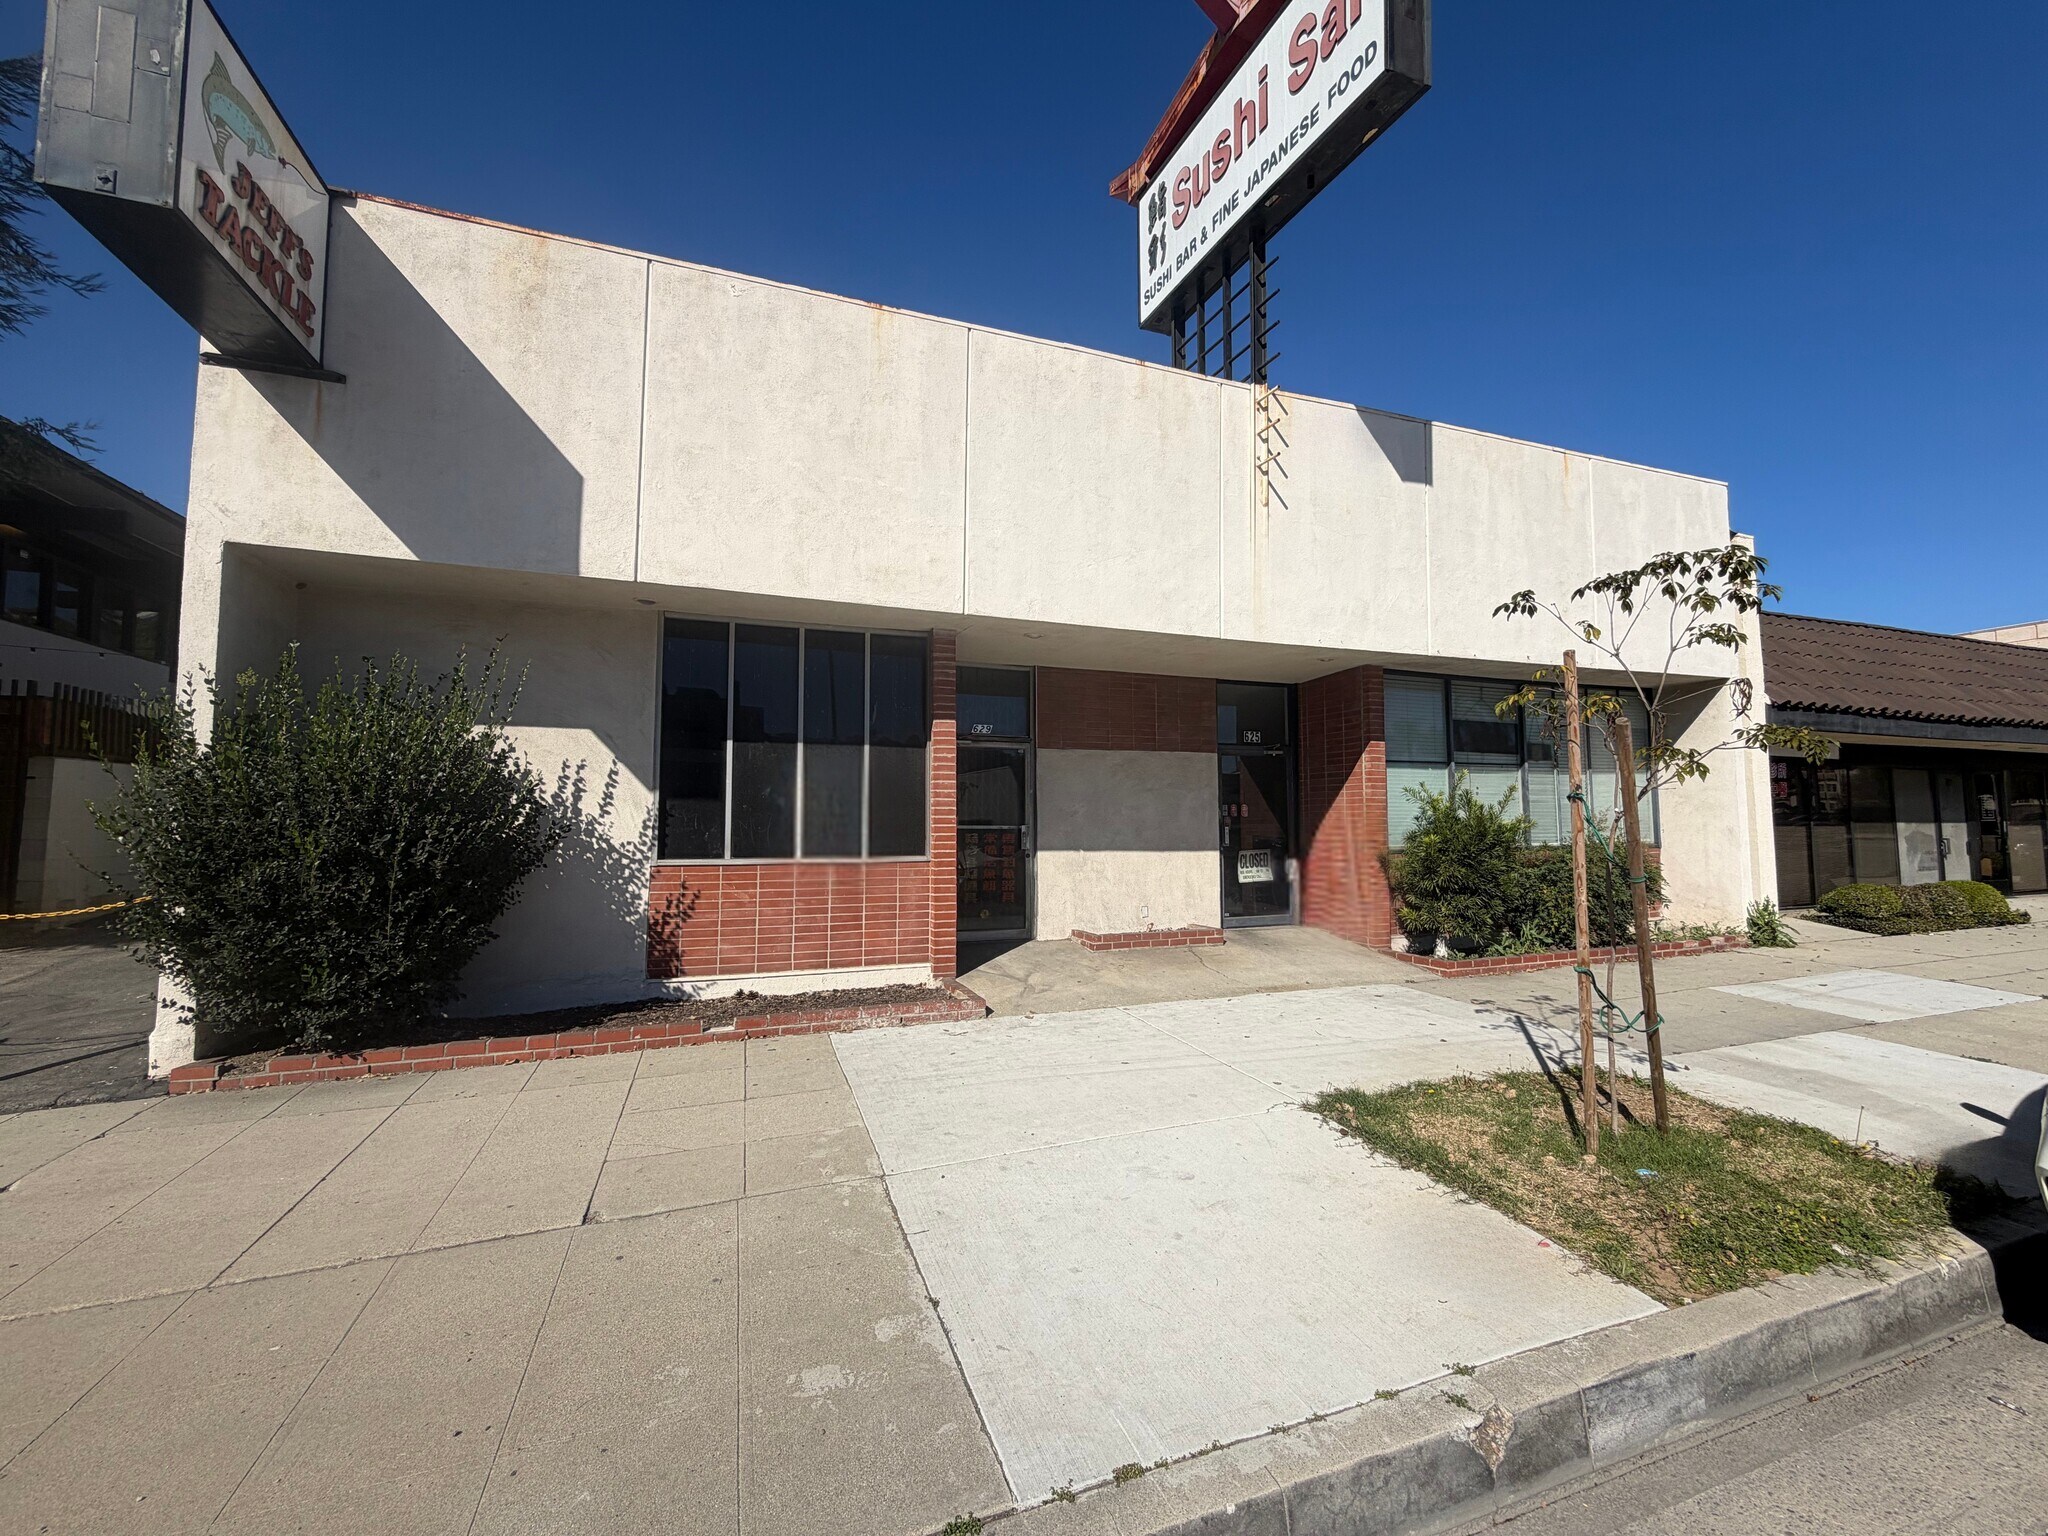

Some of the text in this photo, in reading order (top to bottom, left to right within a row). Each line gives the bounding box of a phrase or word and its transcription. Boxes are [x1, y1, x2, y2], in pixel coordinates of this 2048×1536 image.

[1144, 40, 1377, 305] SUSHI BAR & FINE JAPANESE FOOD
[1172, 64, 1268, 231] Sushi
[198, 168, 316, 337] TACKLE
[973, 725, 991, 733] 629
[1244, 731, 1260, 742] 625
[1240, 852, 1269, 869] CLOSED
